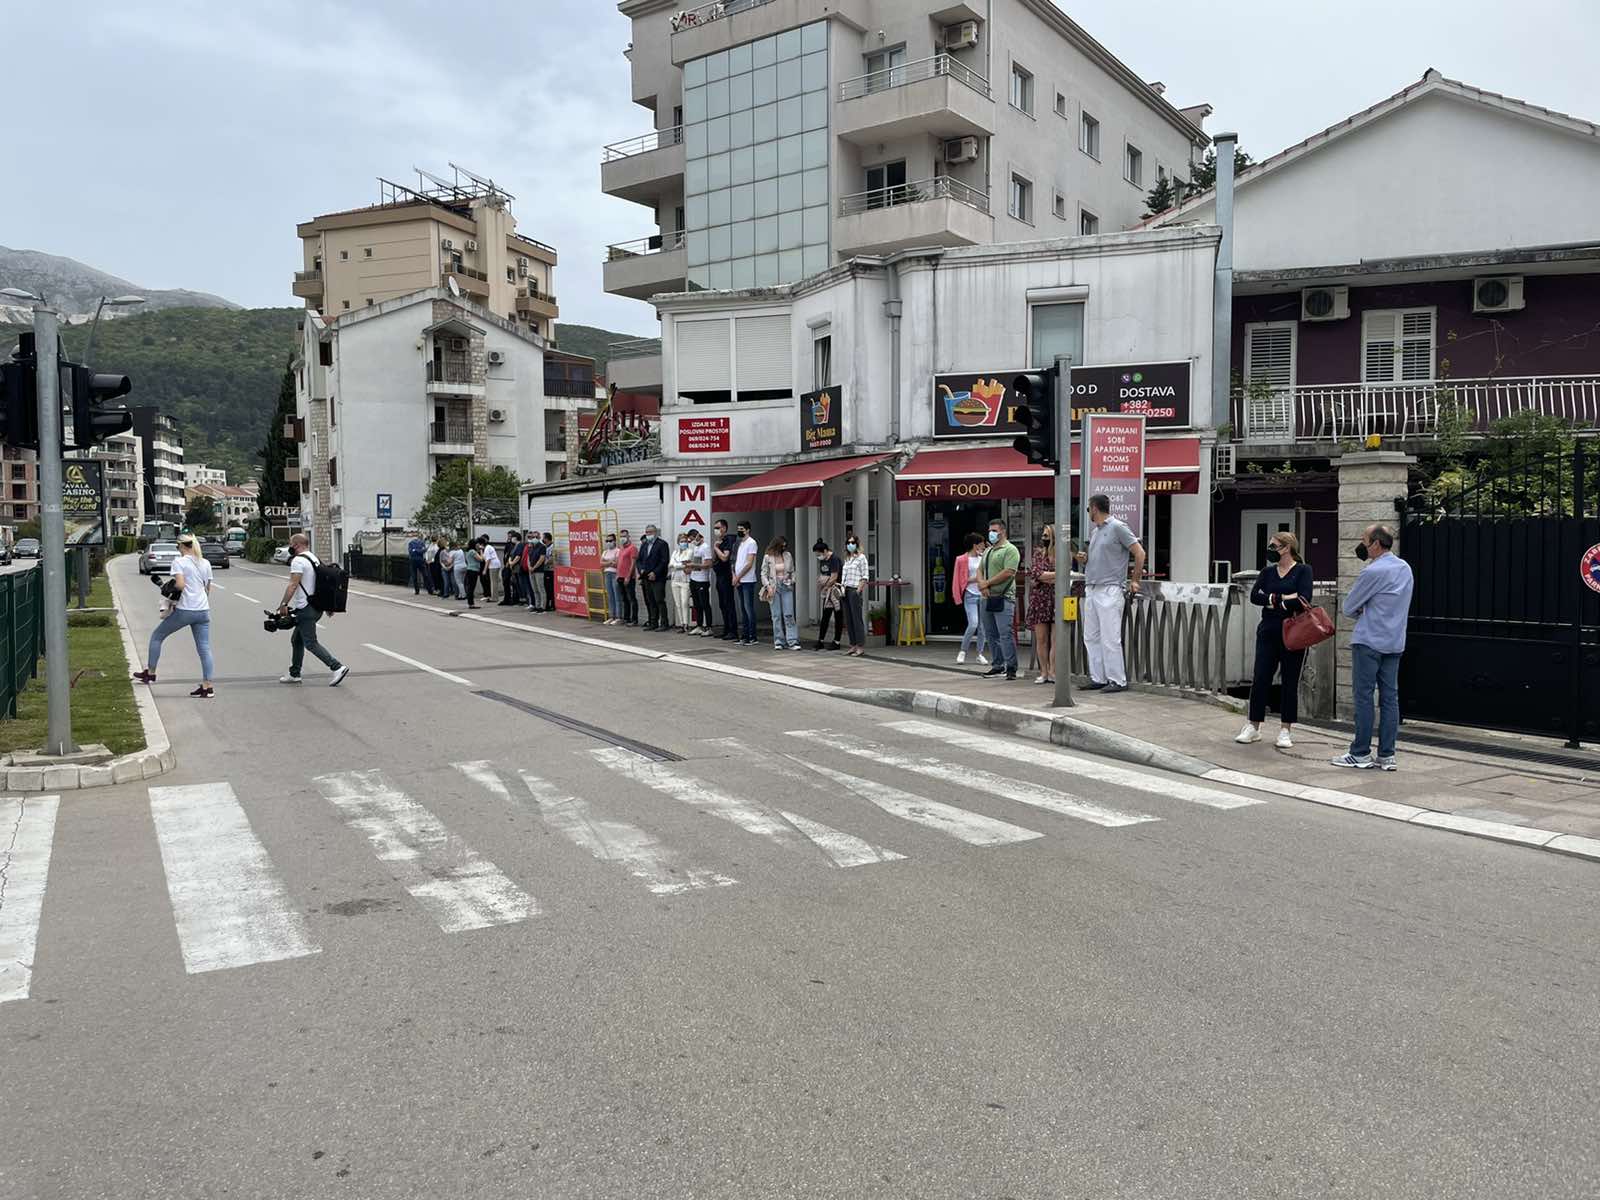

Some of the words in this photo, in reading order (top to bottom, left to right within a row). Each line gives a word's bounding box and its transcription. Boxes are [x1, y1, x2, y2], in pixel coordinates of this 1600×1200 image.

[1070, 384, 1098, 394] OD
[1120, 386, 1176, 398] DOSTAVA
[1123, 400, 1148, 409] +382
[1107, 436, 1126, 444] SOBE
[1095, 485, 1137, 493] APARTMANI
[1144, 478, 1182, 491] ama
[908, 484, 941, 497] FAST
[950, 483, 991, 496] FOOD
